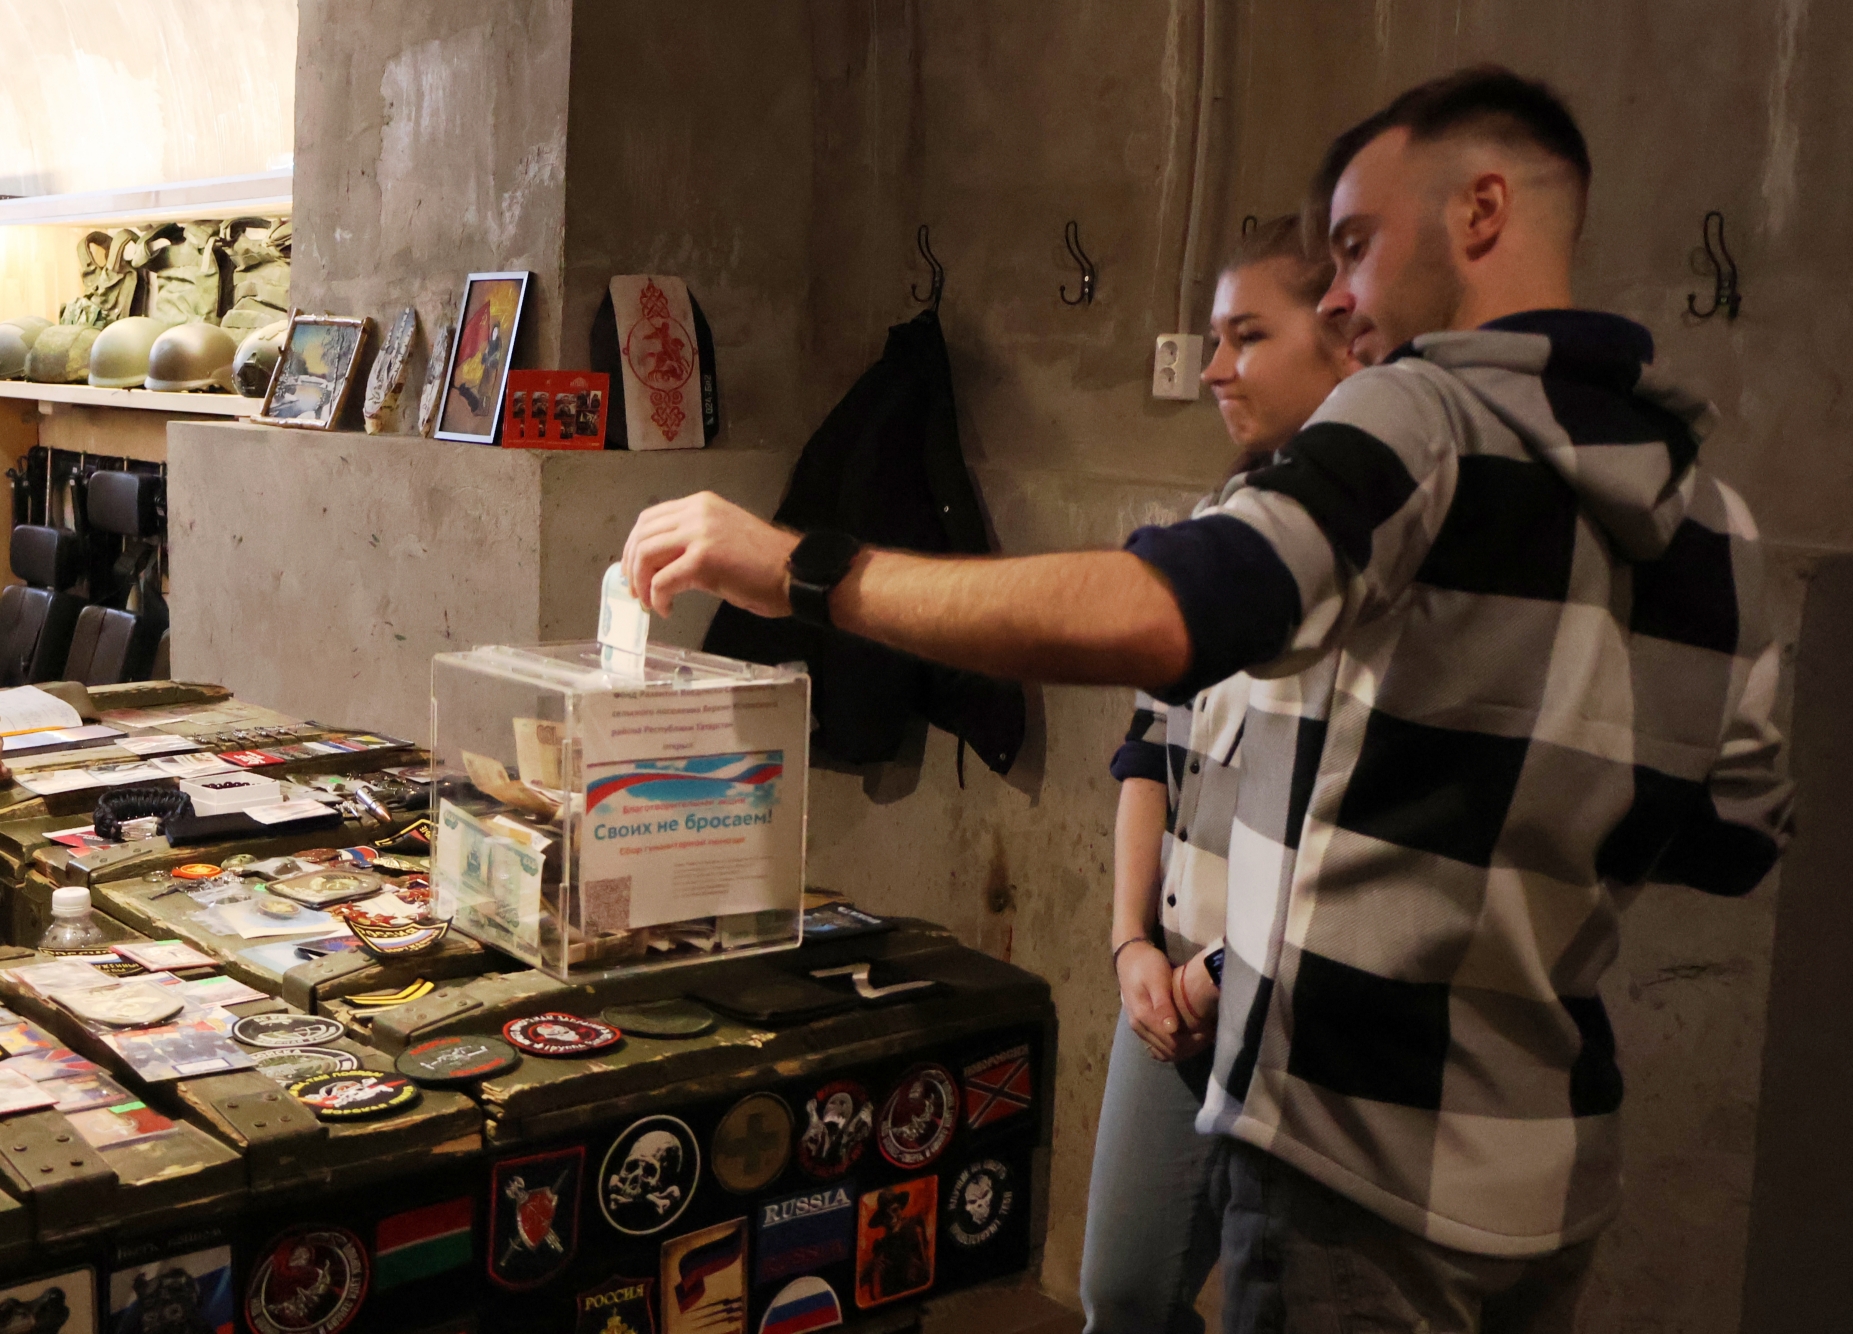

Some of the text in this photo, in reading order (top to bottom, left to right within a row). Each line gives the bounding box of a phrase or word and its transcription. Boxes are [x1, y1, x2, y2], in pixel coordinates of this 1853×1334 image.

[594, 808, 773, 841] Своих не бросаем!
[763, 1187, 850, 1224] RUSSIA
[584, 1283, 645, 1311] РОССИЯ
